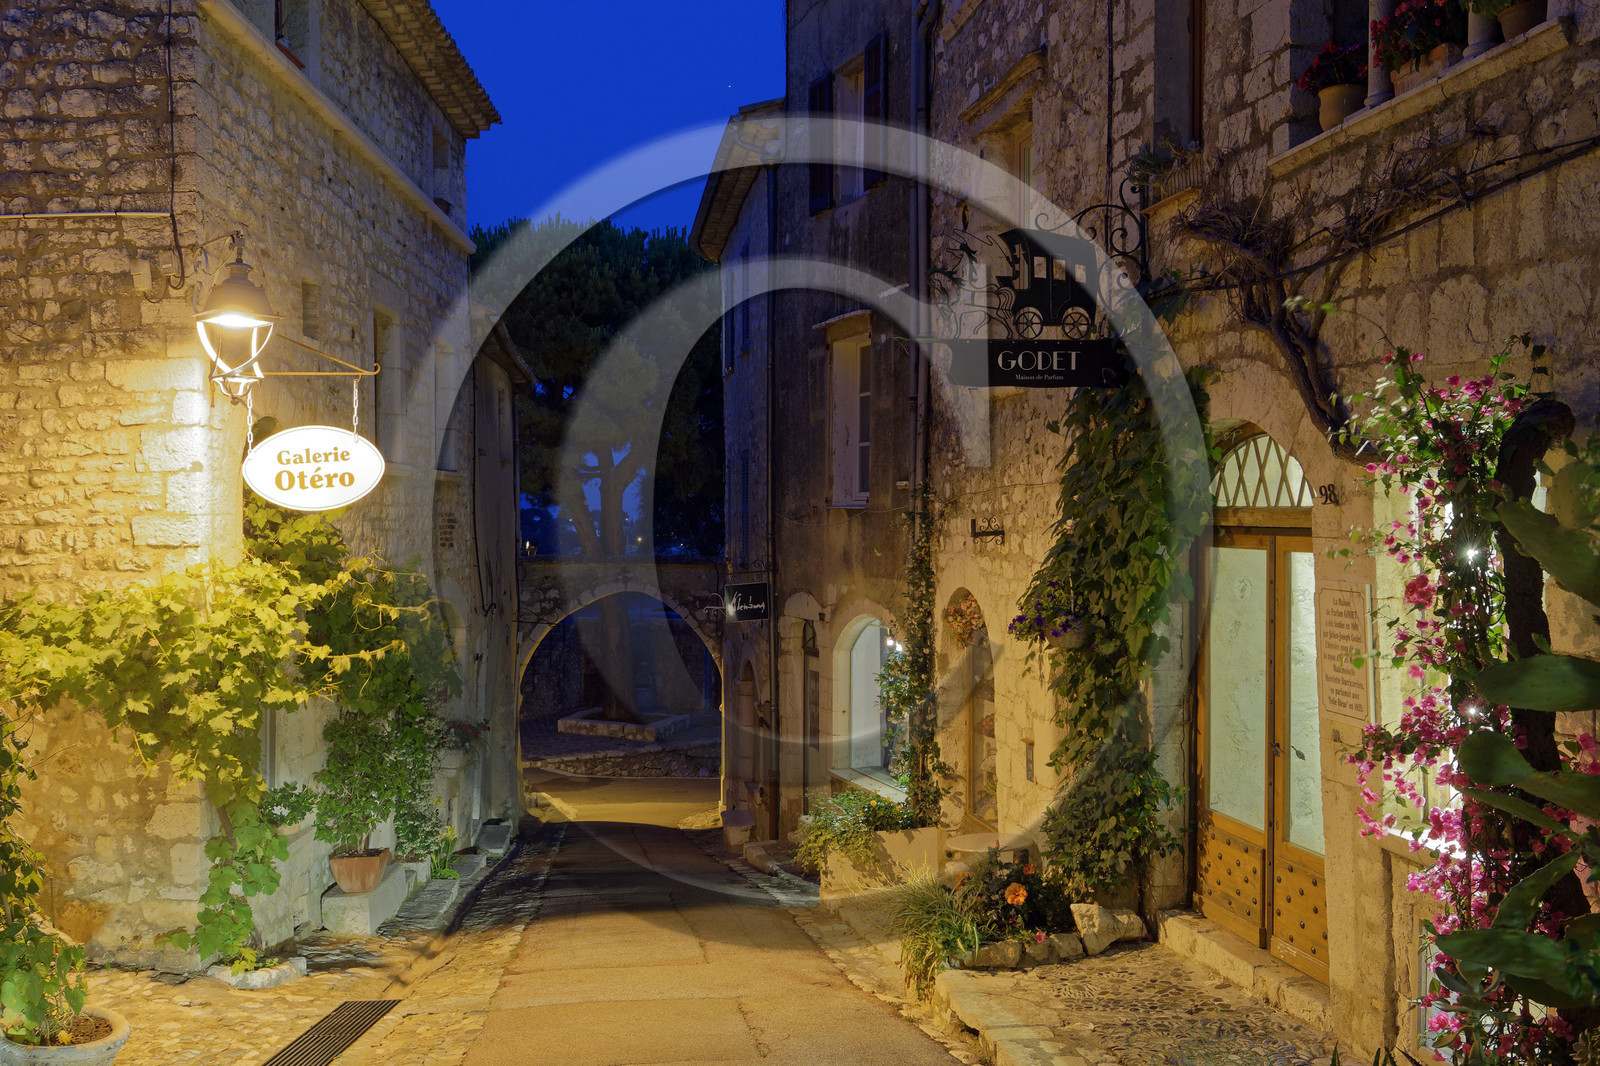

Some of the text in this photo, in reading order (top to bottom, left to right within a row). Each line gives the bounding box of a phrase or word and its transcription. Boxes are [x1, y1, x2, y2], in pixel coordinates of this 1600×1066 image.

[997, 350, 1082, 371] GODET
[276, 446, 351, 465] Galerie
[274, 466, 355, 491] Otéro
[1318, 483, 1340, 506] 98
